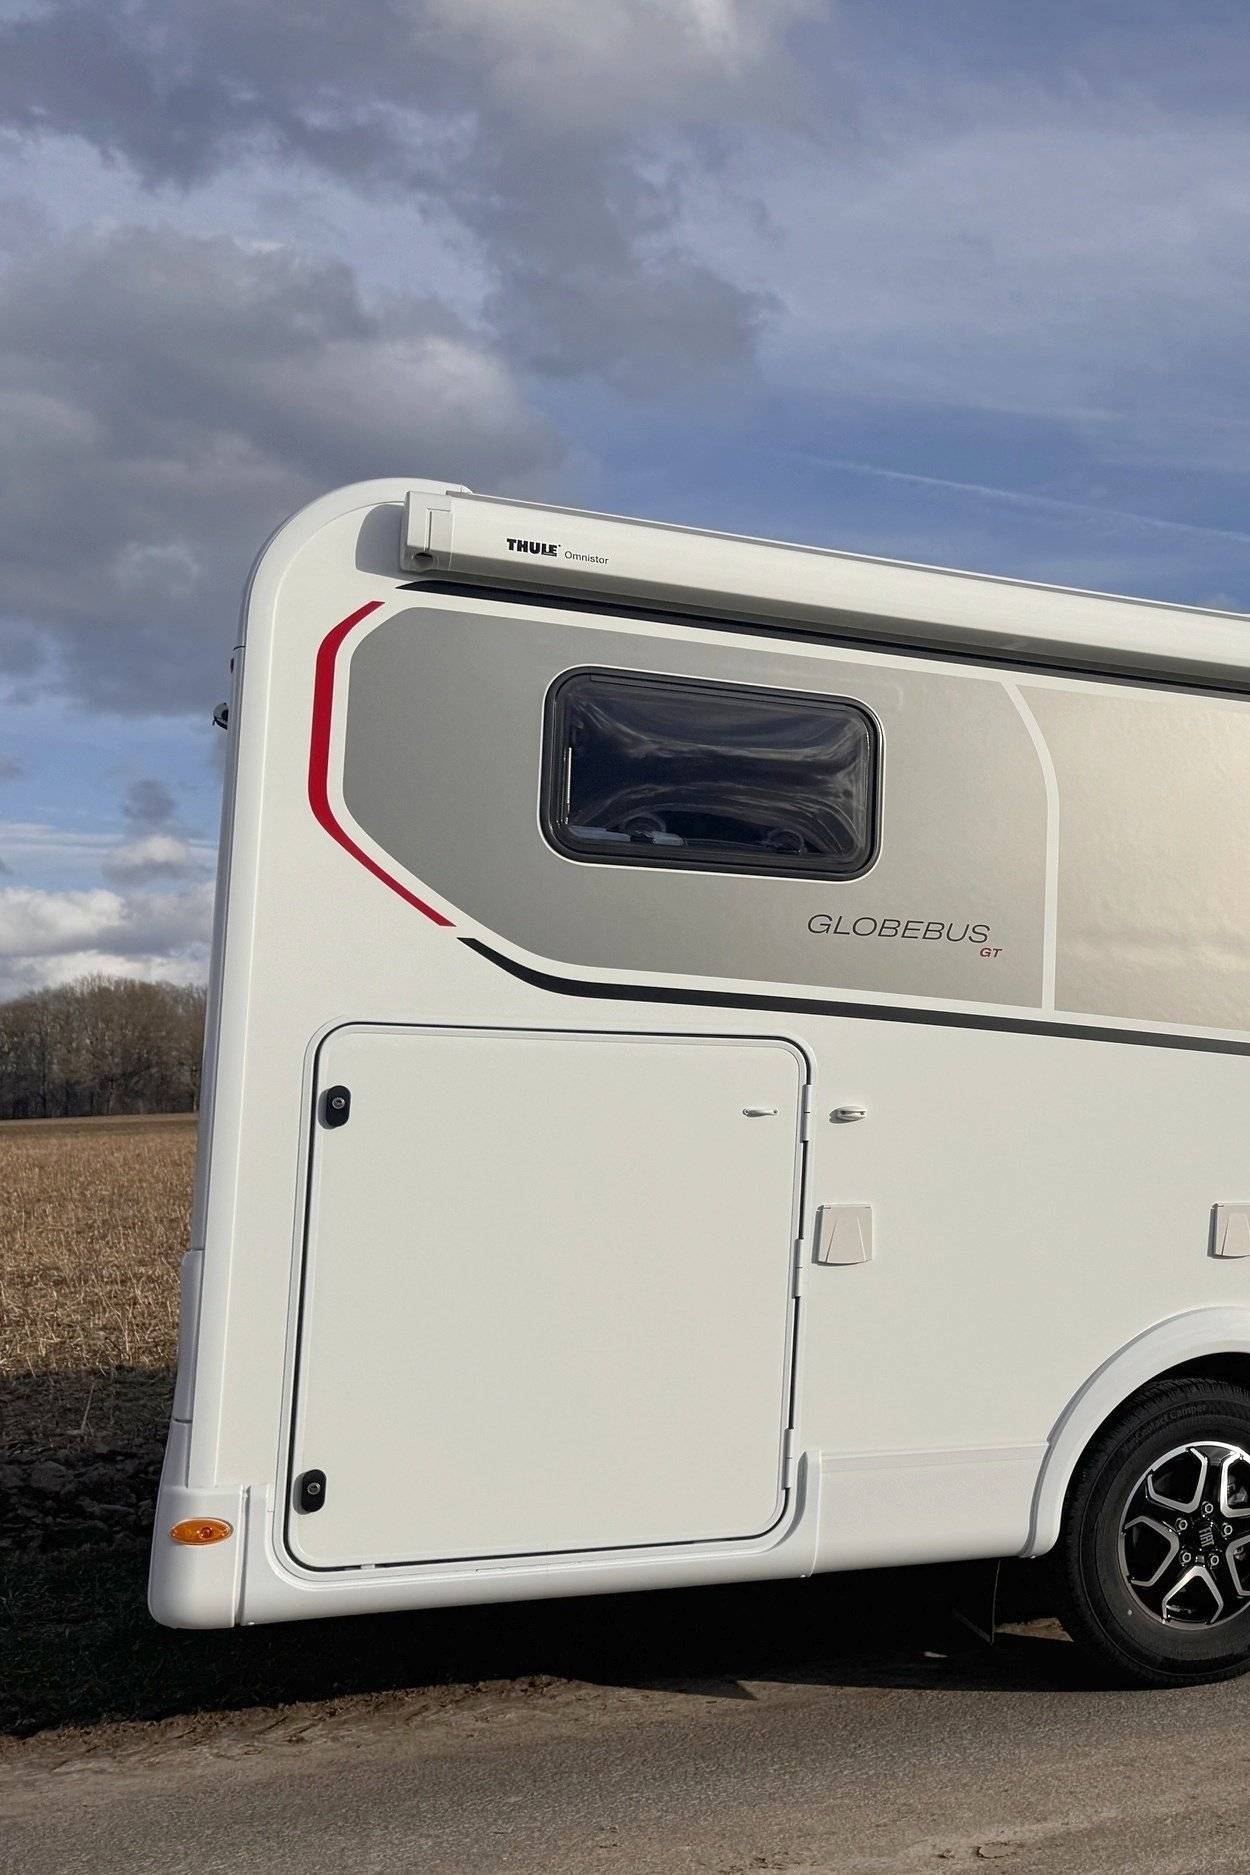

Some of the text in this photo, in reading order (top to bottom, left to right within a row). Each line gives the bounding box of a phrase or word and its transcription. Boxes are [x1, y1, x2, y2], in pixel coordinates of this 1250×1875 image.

[506, 538, 609, 565] THULE Omnistor
[807, 914, 991, 944] GLOBEBUS
[979, 947, 1003, 958] GT
[1198, 1526, 1215, 1548] FIAT
